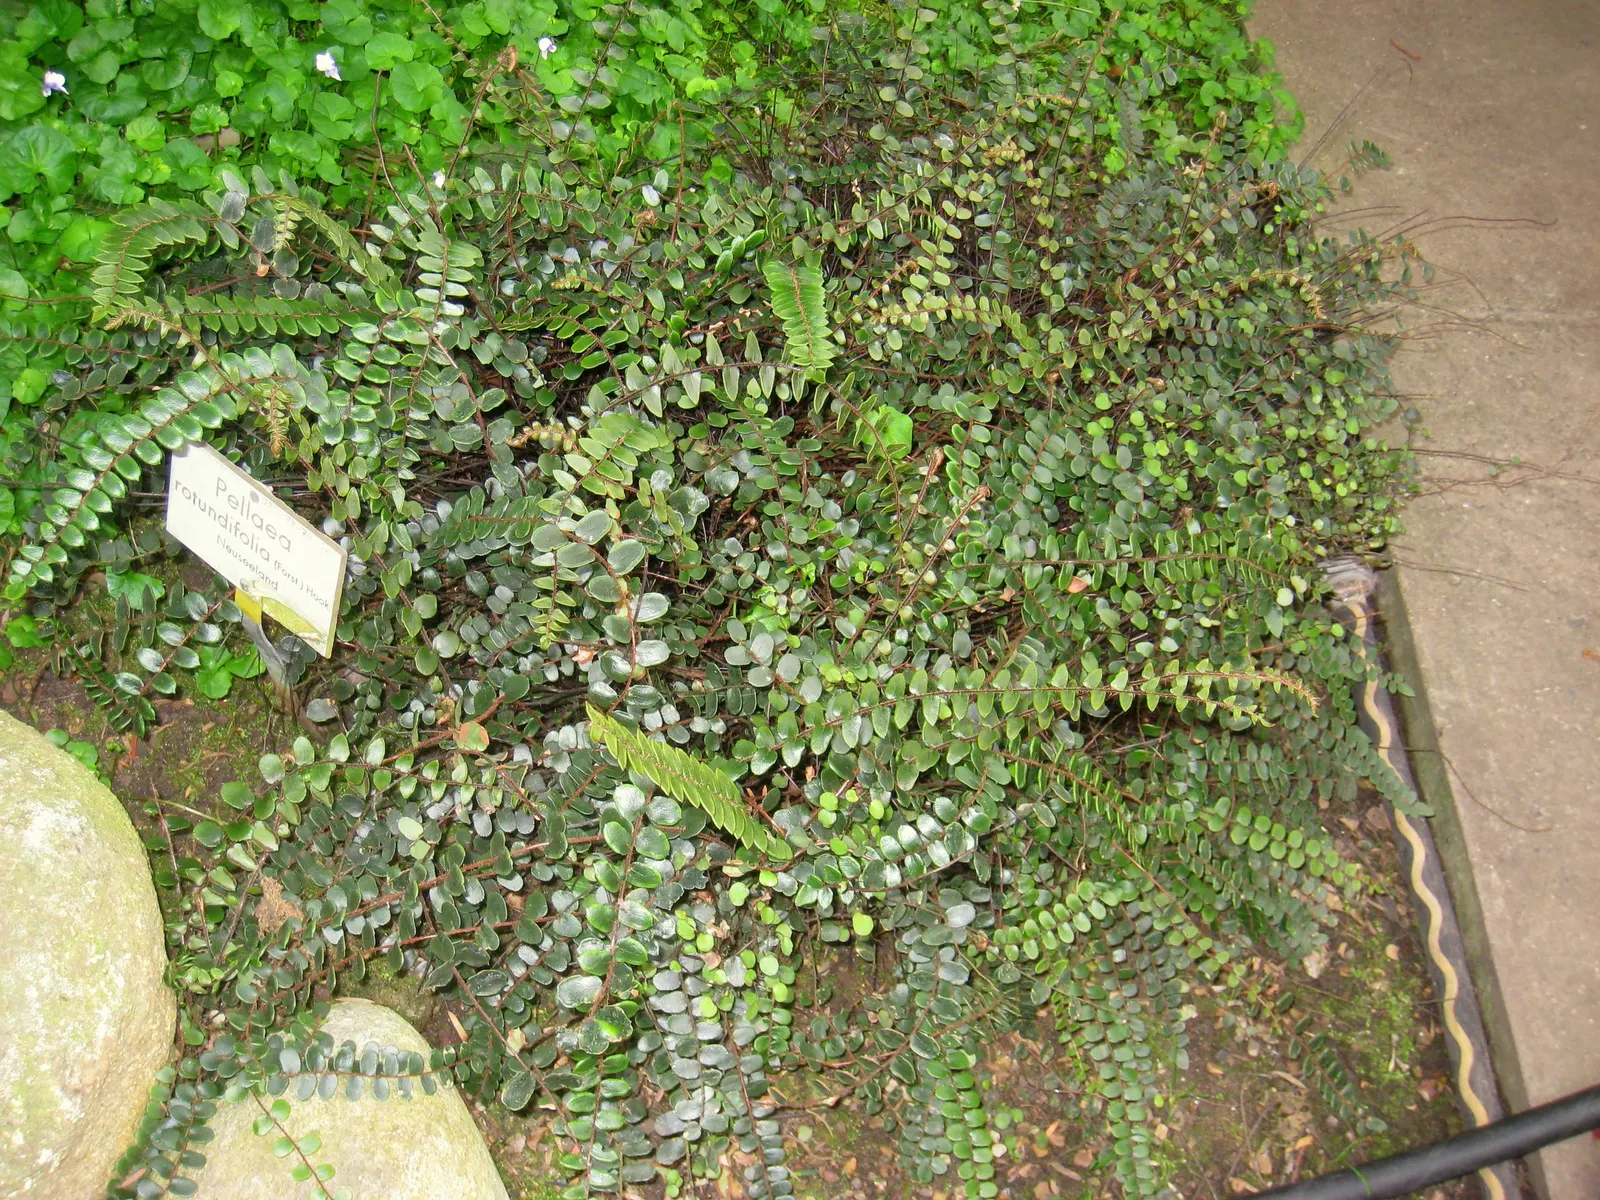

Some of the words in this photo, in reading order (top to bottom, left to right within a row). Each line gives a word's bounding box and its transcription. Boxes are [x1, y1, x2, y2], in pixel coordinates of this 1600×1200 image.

[174, 479, 270, 562] rotundifolia
[215, 477, 291, 553] Pellaea
[216, 534, 278, 591] Neuseeland
